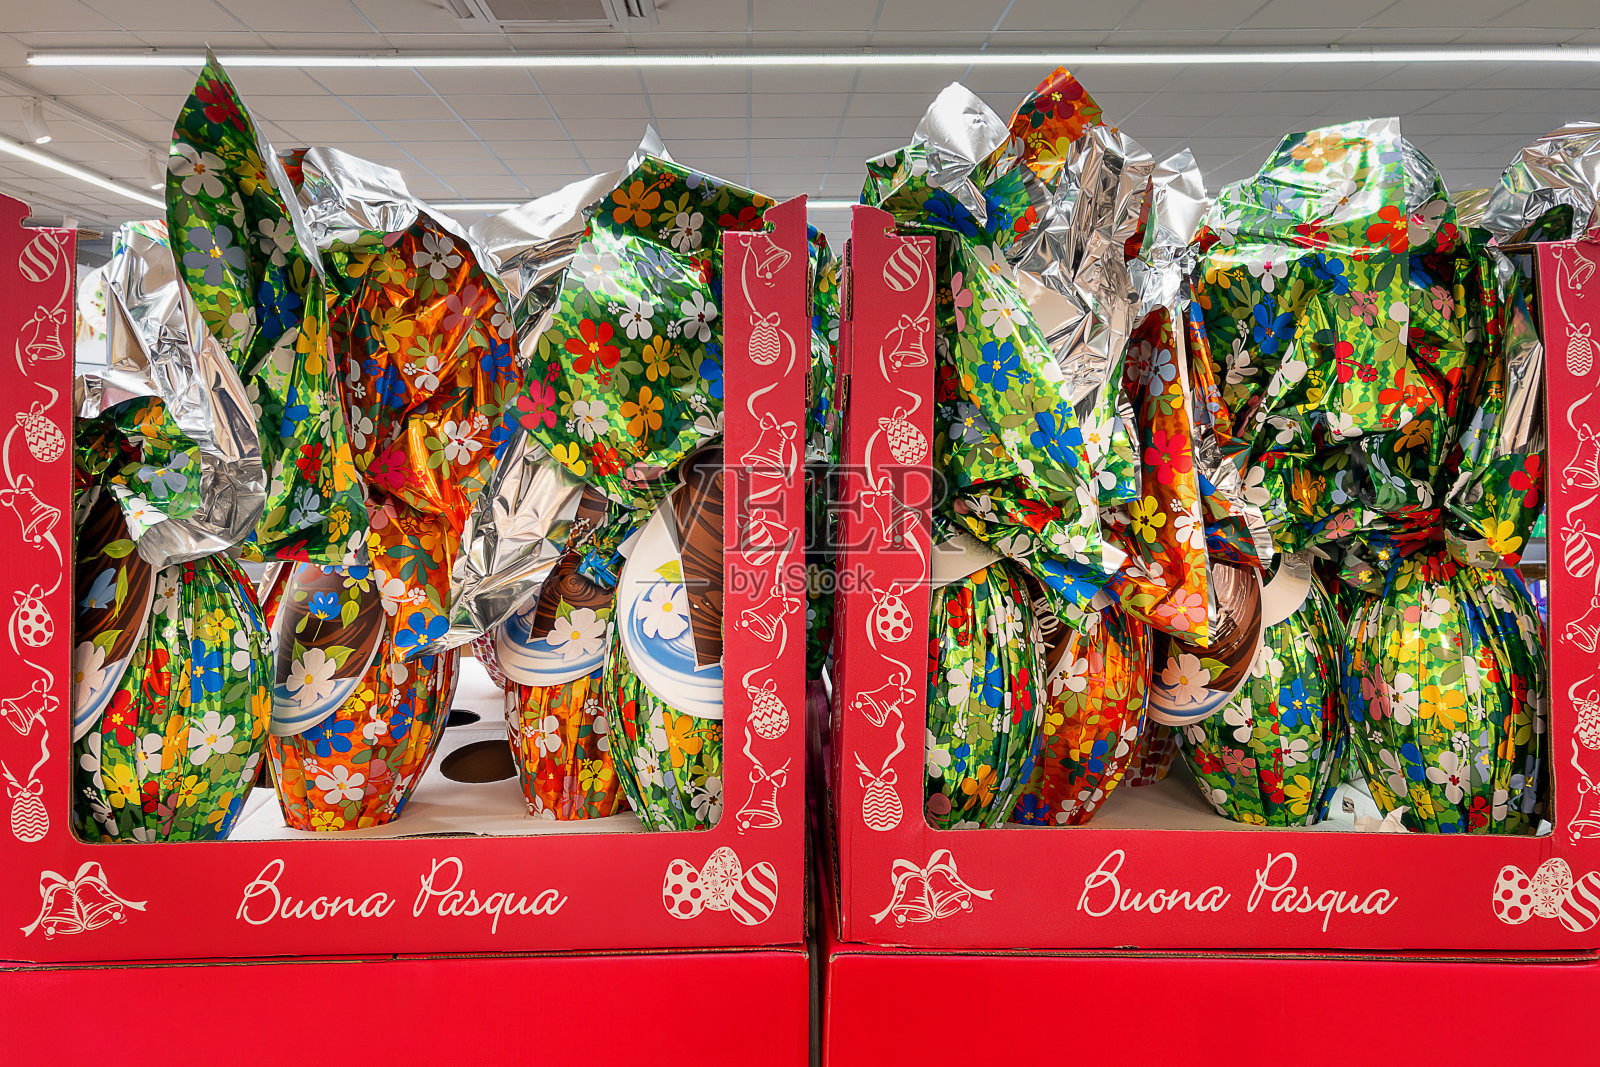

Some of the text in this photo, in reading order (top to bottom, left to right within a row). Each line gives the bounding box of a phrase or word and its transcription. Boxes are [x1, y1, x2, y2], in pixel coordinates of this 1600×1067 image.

[235, 856, 569, 935] Buona Pasqua
[1077, 850, 1399, 933] Buona Pasqua
